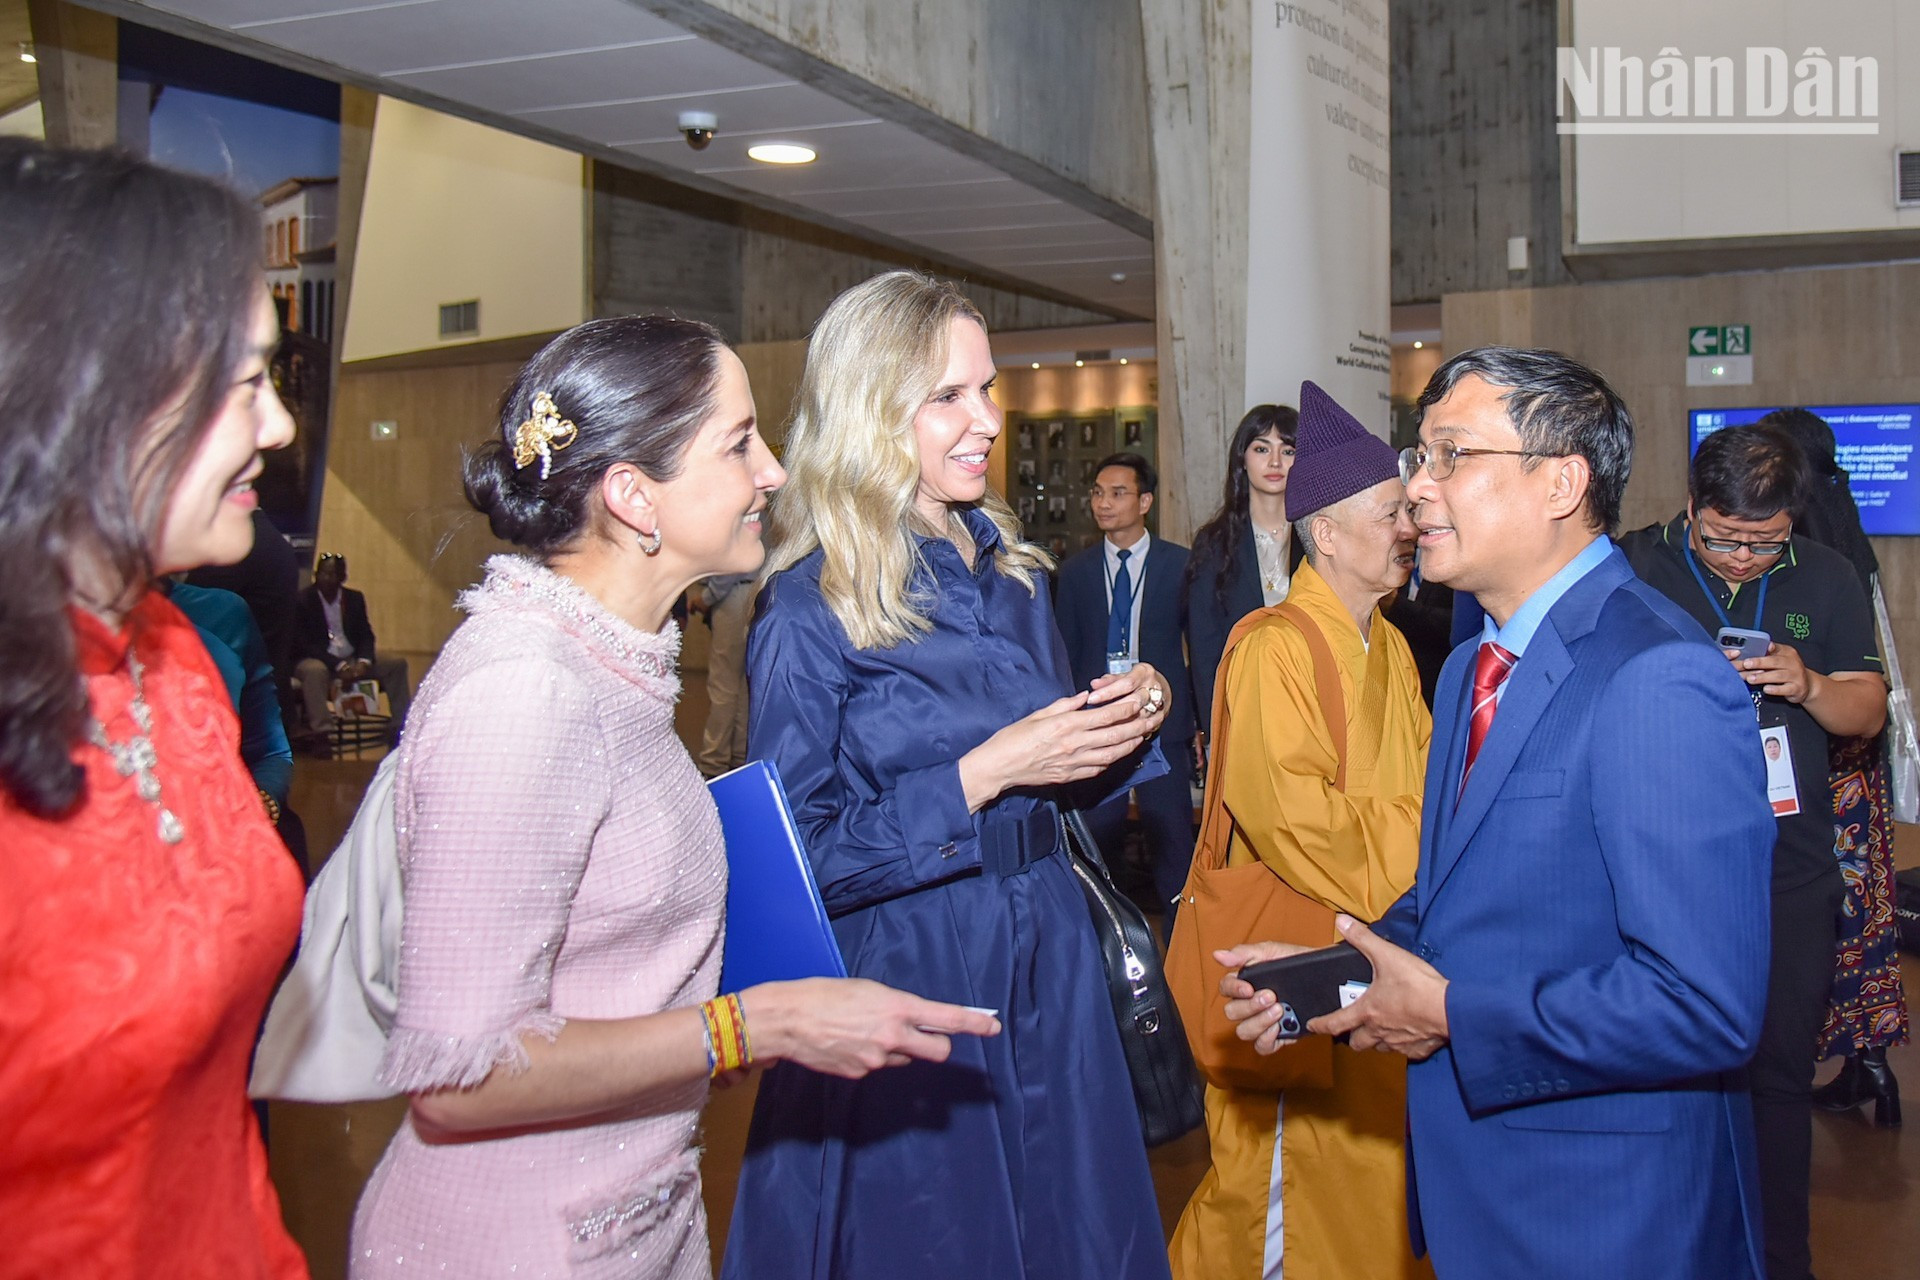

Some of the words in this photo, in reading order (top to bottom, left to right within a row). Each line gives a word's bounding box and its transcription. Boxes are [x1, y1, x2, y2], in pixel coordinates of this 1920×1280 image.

[1336, 355, 1354, 367] World
[1861, 443, 1913, 455] numériques
[1841, 453, 1908, 464] développement
[1872, 470, 1909, 481] mondial
